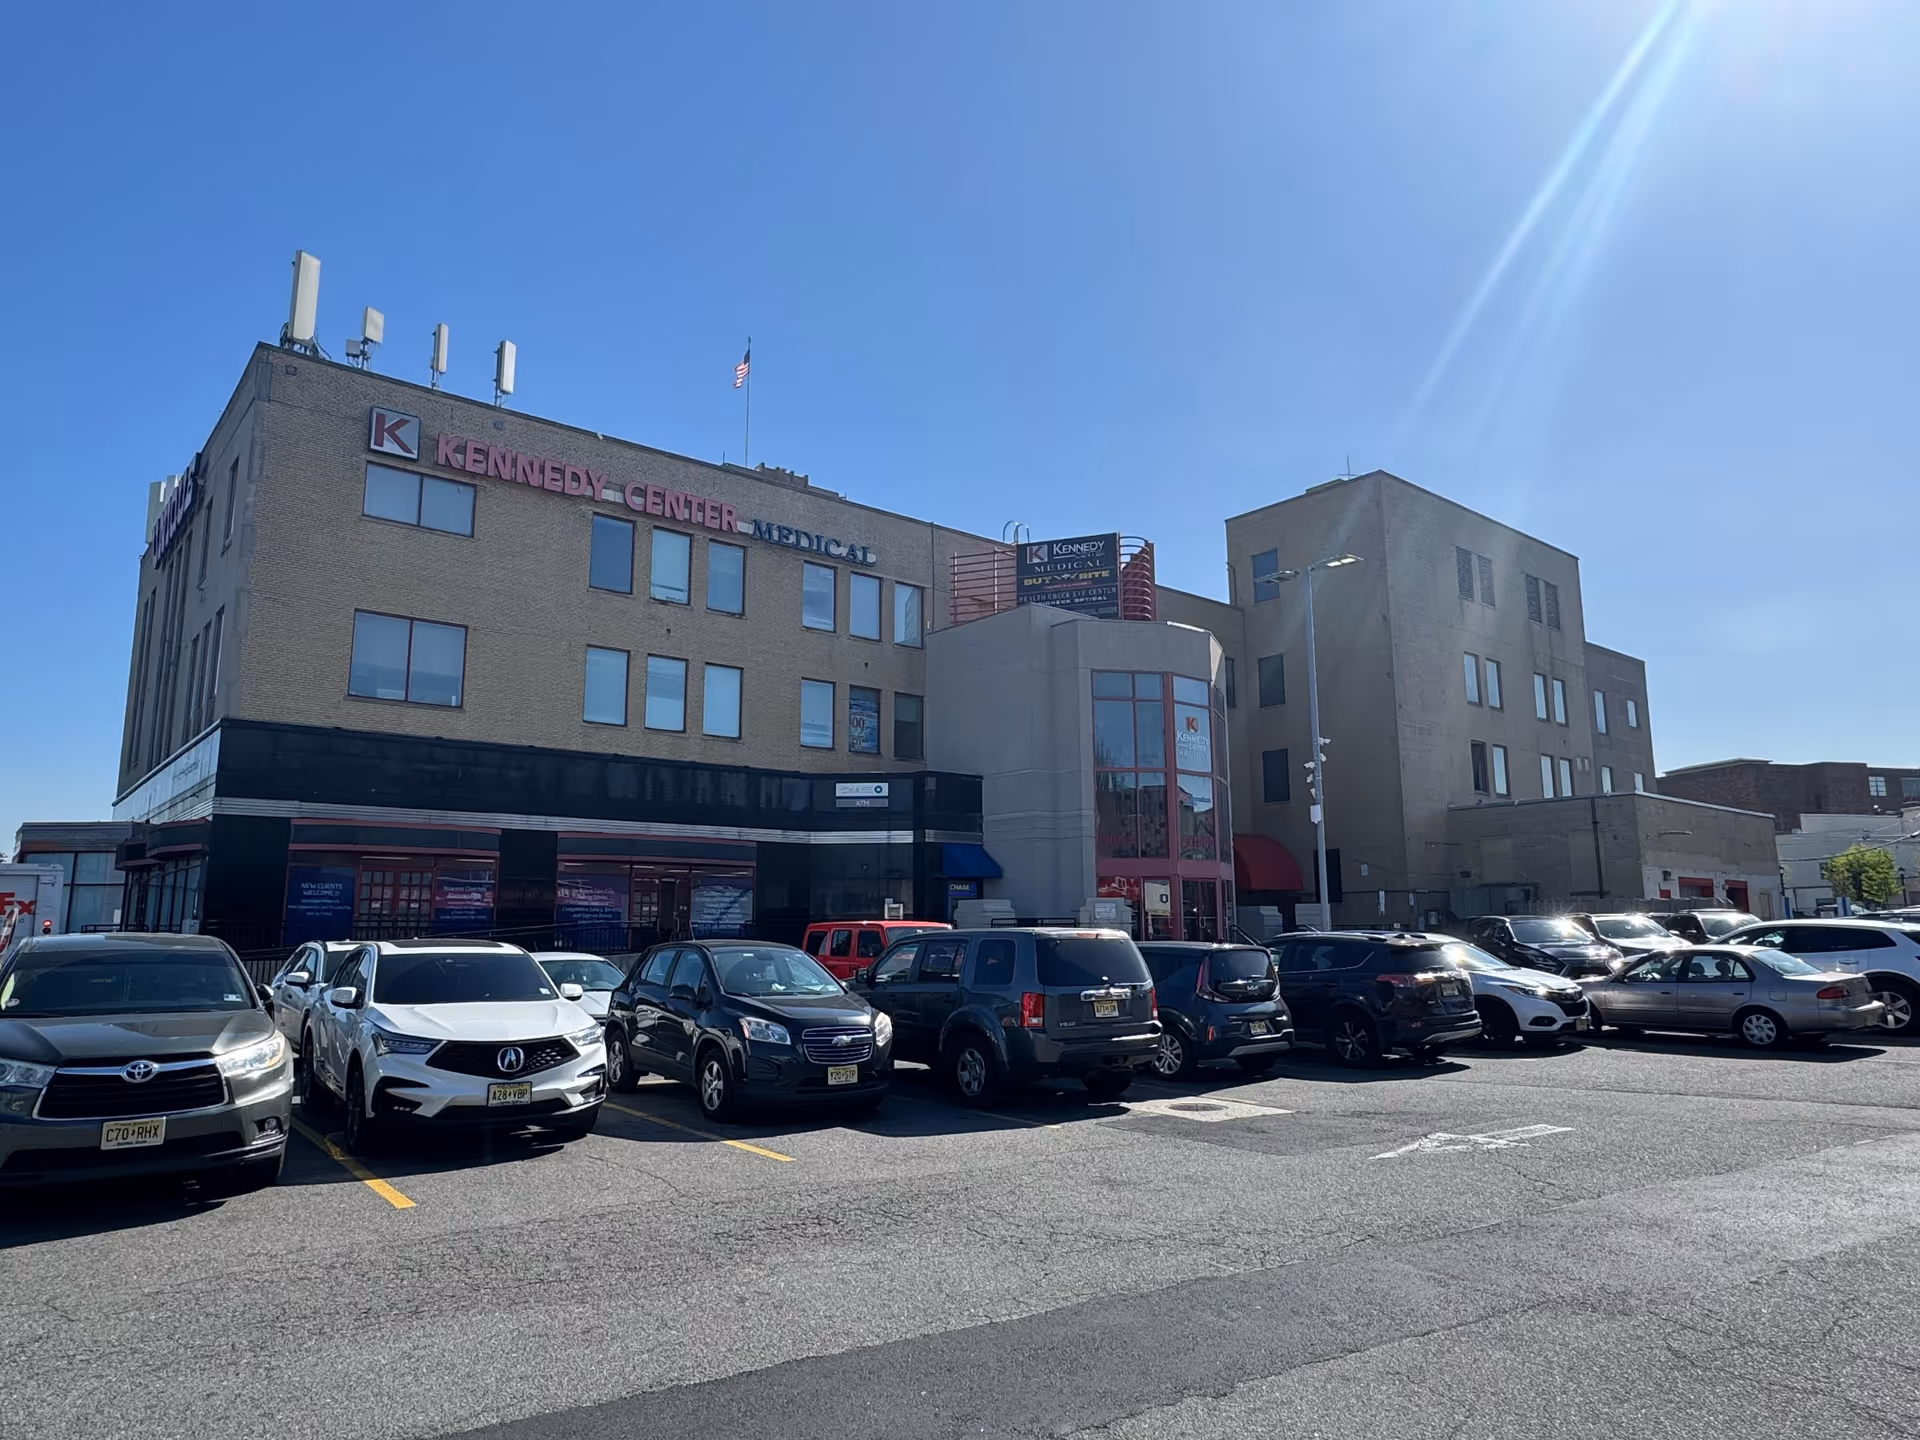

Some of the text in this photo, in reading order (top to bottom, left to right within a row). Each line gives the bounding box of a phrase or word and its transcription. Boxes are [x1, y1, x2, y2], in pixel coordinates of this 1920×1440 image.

[372, 412, 415, 454] K
[436, 432, 877, 566] KENNEDY CENTER MEDICAL
[1053, 540, 1105, 555] KENNEDY
[1034, 560, 1105, 573] MEDICAL
[1023, 576, 1052, 586] BUY
[1078, 570, 1110, 580] RITE
[1019, 593, 1046, 603] HEALTH
[1048, 591, 1070, 600] CHECK
[1073, 589, 1087, 597] EYE
[1089, 586, 1117, 596] CENTER
[317, 882, 343, 890] CLIENTS
